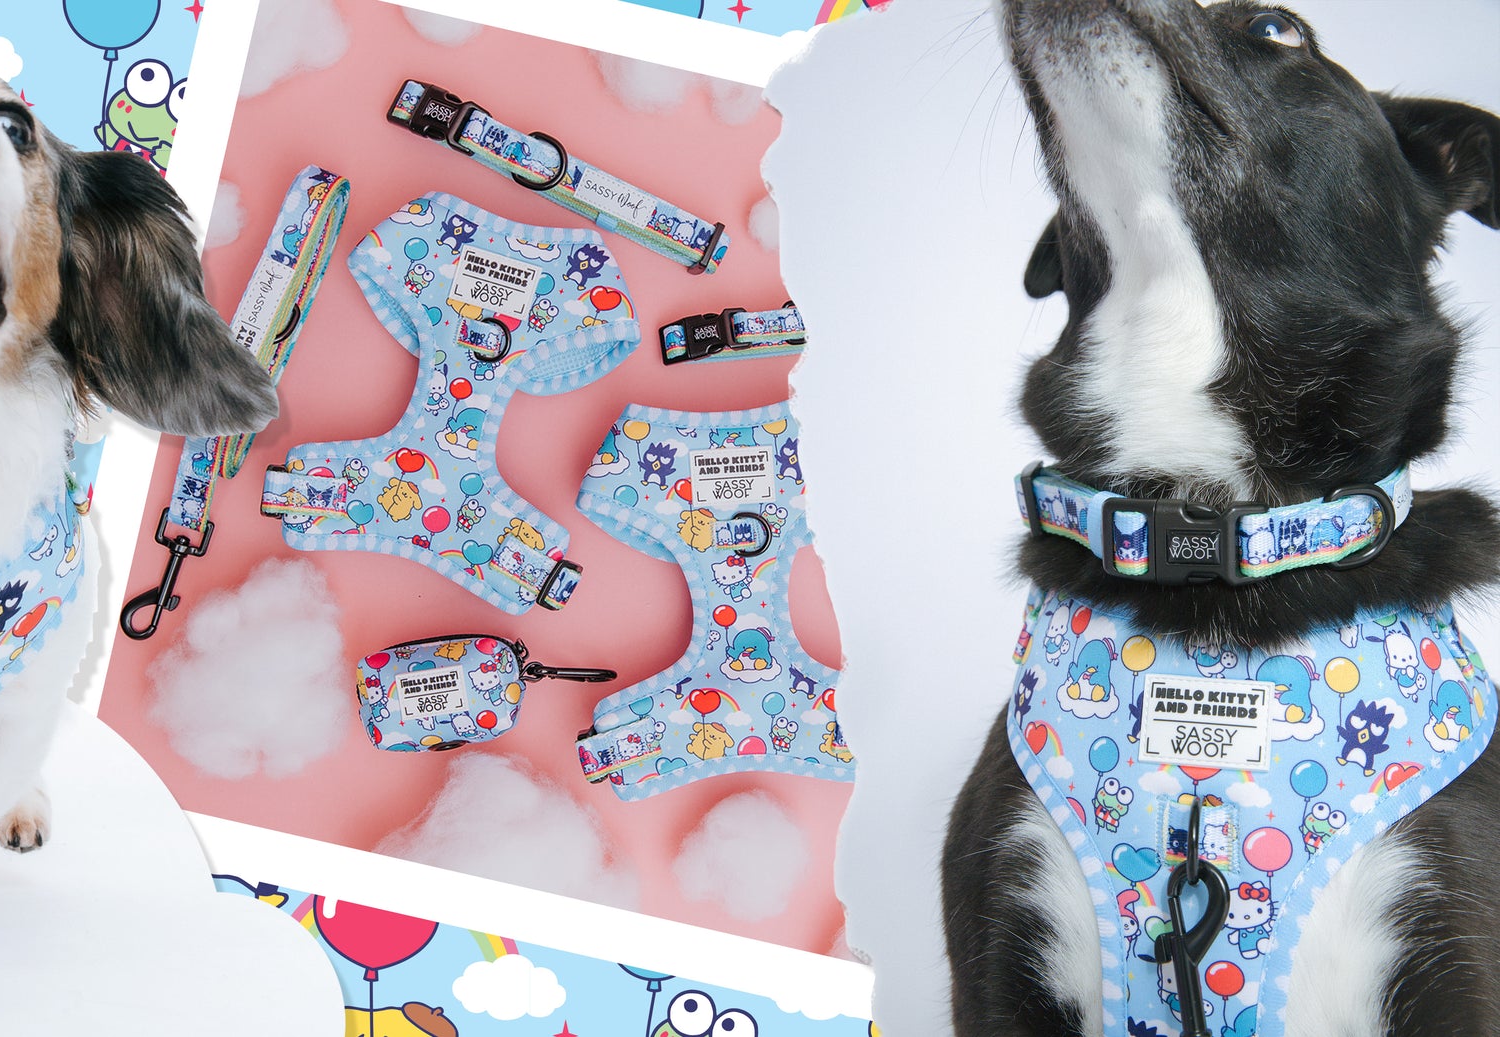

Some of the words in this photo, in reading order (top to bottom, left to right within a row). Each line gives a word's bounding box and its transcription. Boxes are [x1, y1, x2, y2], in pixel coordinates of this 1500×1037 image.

[430, 103, 455, 118] SASSY
[584, 180, 617, 200] SASSY
[617, 193, 647, 219] Woof
[467, 255, 497, 269] HELLO
[499, 264, 531, 278] KITTY
[465, 263, 485, 274] AND
[489, 270, 527, 287] FRIENDS
[249, 294, 266, 323] SASSY
[260, 267, 283, 294] Woof
[471, 288, 508, 306] WOOF
[475, 281, 513, 299] SASSY
[698, 457, 729, 466] HELLO
[732, 455, 764, 464] KITTY
[699, 467, 720, 475] AND
[724, 464, 765, 473] FRIENDS
[715, 479, 754, 490] SASSY
[713, 488, 752, 499] WOOF
[1172, 537, 1218, 548] SASSY
[1169, 547, 1215, 559] WOOF
[403, 678, 428, 687] HELLO
[430, 674, 455, 683] KITTY
[424, 681, 456, 691] FRIENDS
[418, 694, 448, 705] SASSY
[1156, 688, 1204, 701] HELLO
[1208, 691, 1259, 705] KITTY
[417, 702, 448, 713] WOOF
[1155, 701, 1188, 713] AND
[1194, 704, 1257, 719] FRIENDS
[1176, 725, 1237, 743] SASSY
[1171, 739, 1233, 758] WOOF
